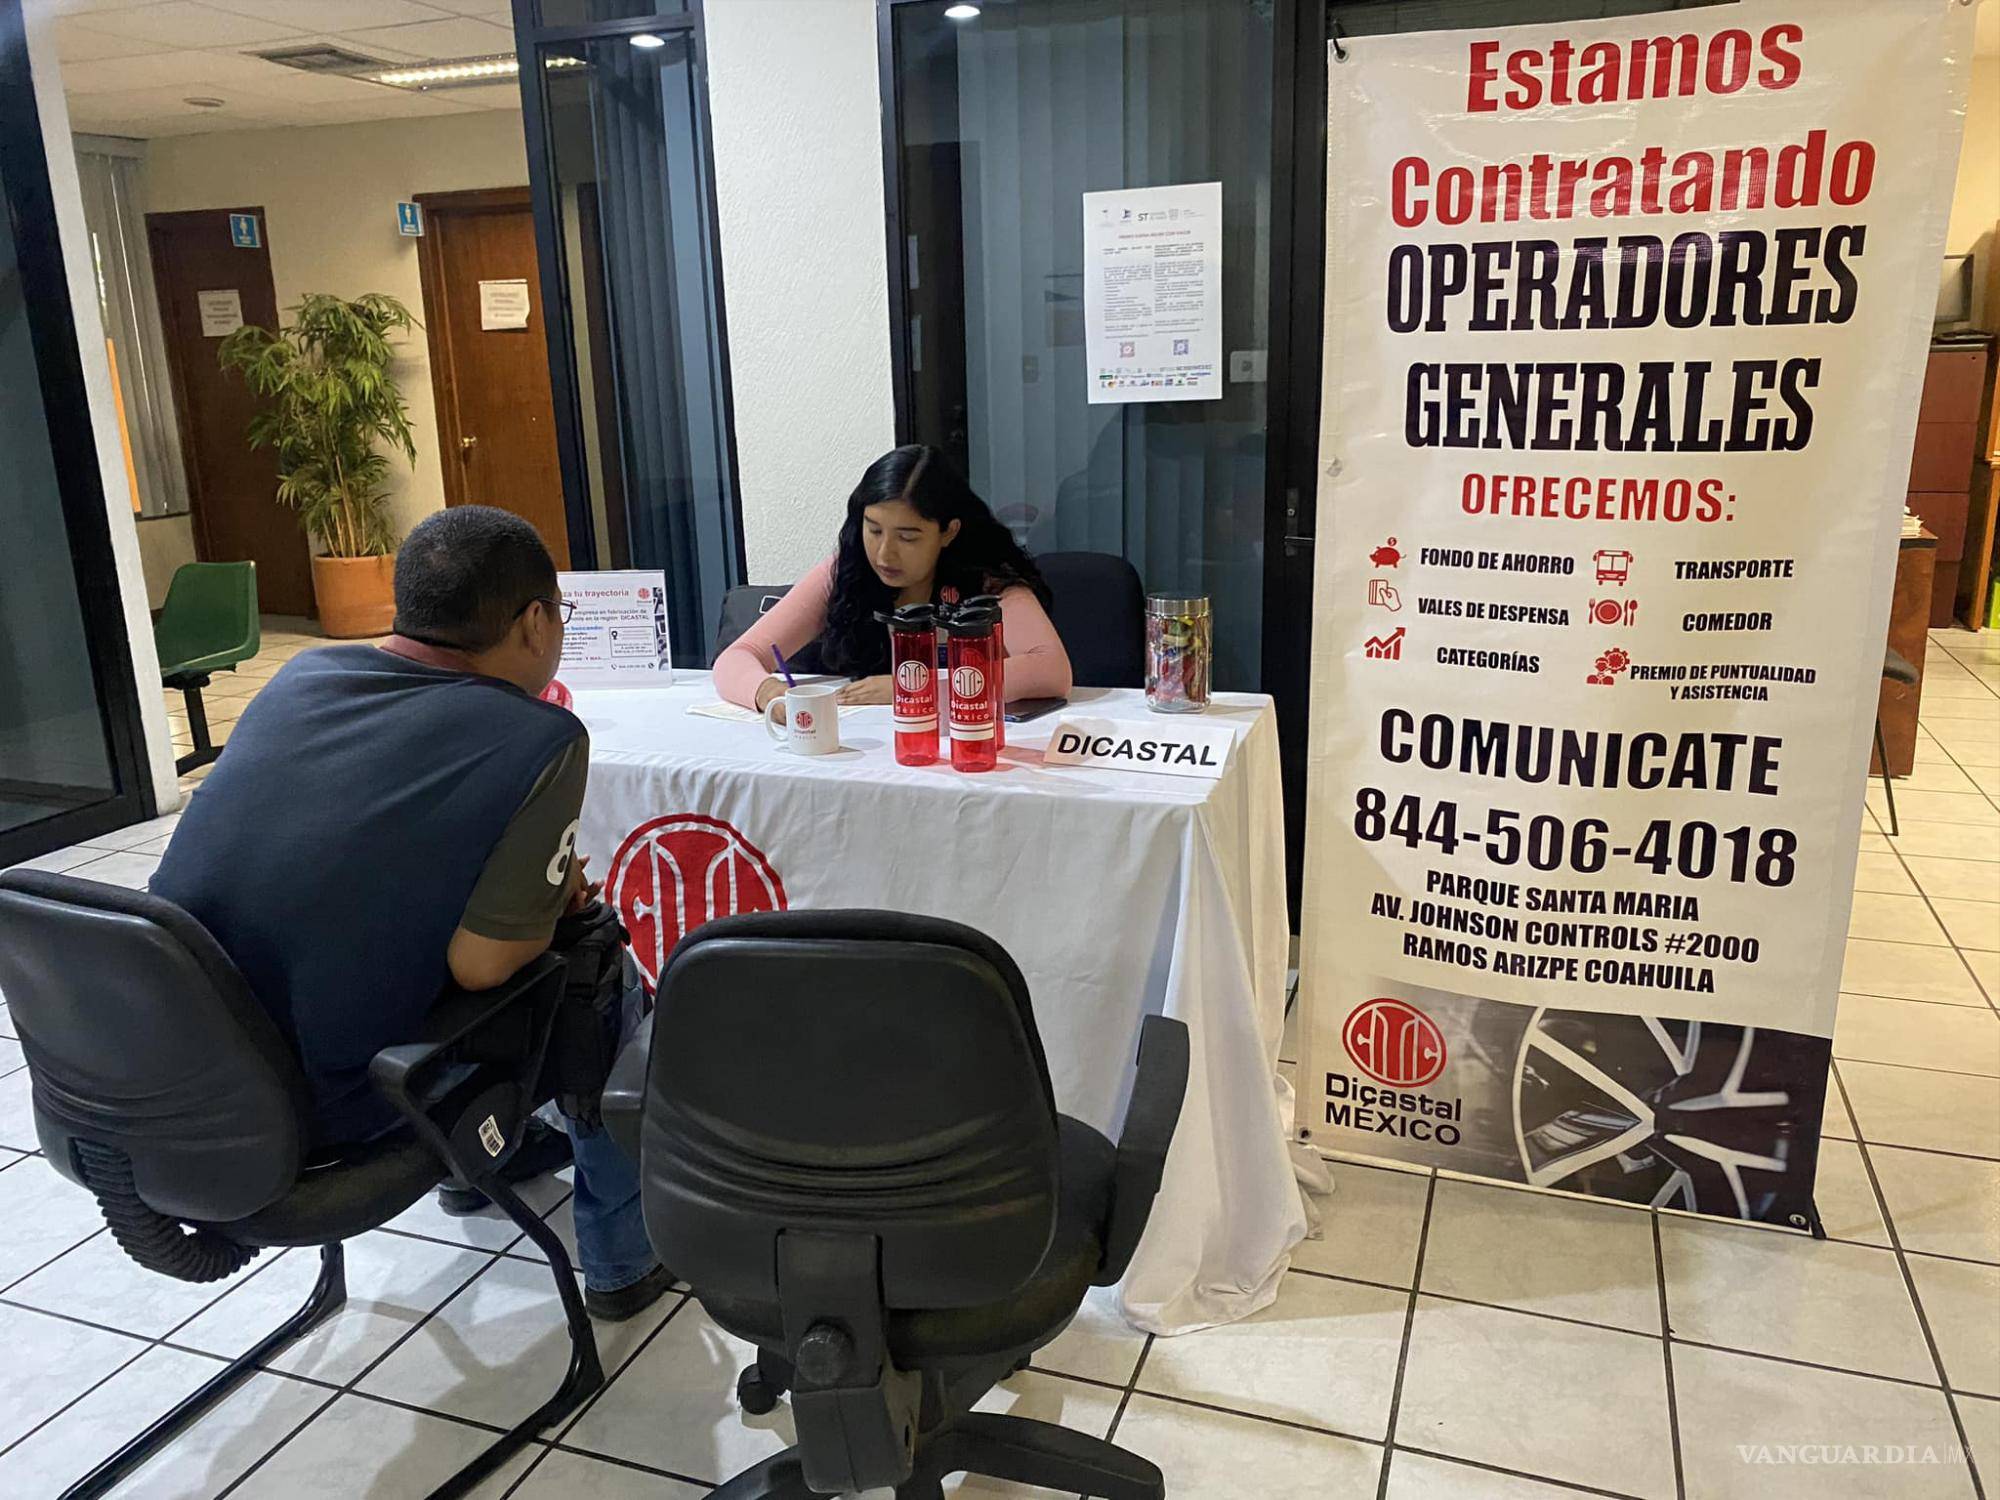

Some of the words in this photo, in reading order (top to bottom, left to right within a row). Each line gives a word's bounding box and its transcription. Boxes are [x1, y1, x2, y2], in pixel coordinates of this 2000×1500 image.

[1466, 23, 1803, 113] Estamos
[1391, 129, 1876, 228] Contratando
[1386, 224, 1867, 334] OPERADORES
[1404, 357, 1822, 453] GENERALES
[1461, 473, 1737, 523] OFRECEMOS:
[1420, 547, 1474, 569] FONDO
[1477, 551, 1499, 570] DE
[1501, 553, 1575, 575] AHORRO
[1674, 559, 1795, 580] TRANSPORTE
[574, 590, 583, 598] tu
[585, 588, 629, 598] trayectoria
[1418, 597, 1463, 617] VALES
[1465, 601, 1485, 619] DE
[1488, 603, 1569, 626] DESPENSA
[1682, 612, 1773, 632] COMEDOR
[1436, 646, 1540, 674] CATEGORÍAS
[1630, 665, 1687, 681] PREMIO
[1689, 664, 1709, 680] DE
[1710, 664, 1817, 684] PUNTUALIDAD
[895, 693, 933, 704] Dicastal
[951, 700, 988, 710] Dicastal
[1670, 685, 1680, 700] Y
[1680, 684, 1769, 702] ASISTENCIA
[1057, 733, 1217, 766] DICASTAL
[1380, 708, 1783, 796] COMUNICATE
[1353, 786, 1798, 888] 844-506-4018
[1426, 869, 1520, 909] PARQUE
[1525, 887, 1607, 915] SANTA
[1612, 891, 1700, 922] MARIA
[1370, 892, 1405, 921] AV.
[1408, 900, 1519, 943] JOHNSON
[1525, 921, 1659, 953] CONTROLS
[1664, 932, 1760, 964] #2000
[1403, 932, 1488, 970] RAMOS
[1492, 950, 1579, 982] ARIZPE
[1584, 959, 1715, 994] COAHUILA
